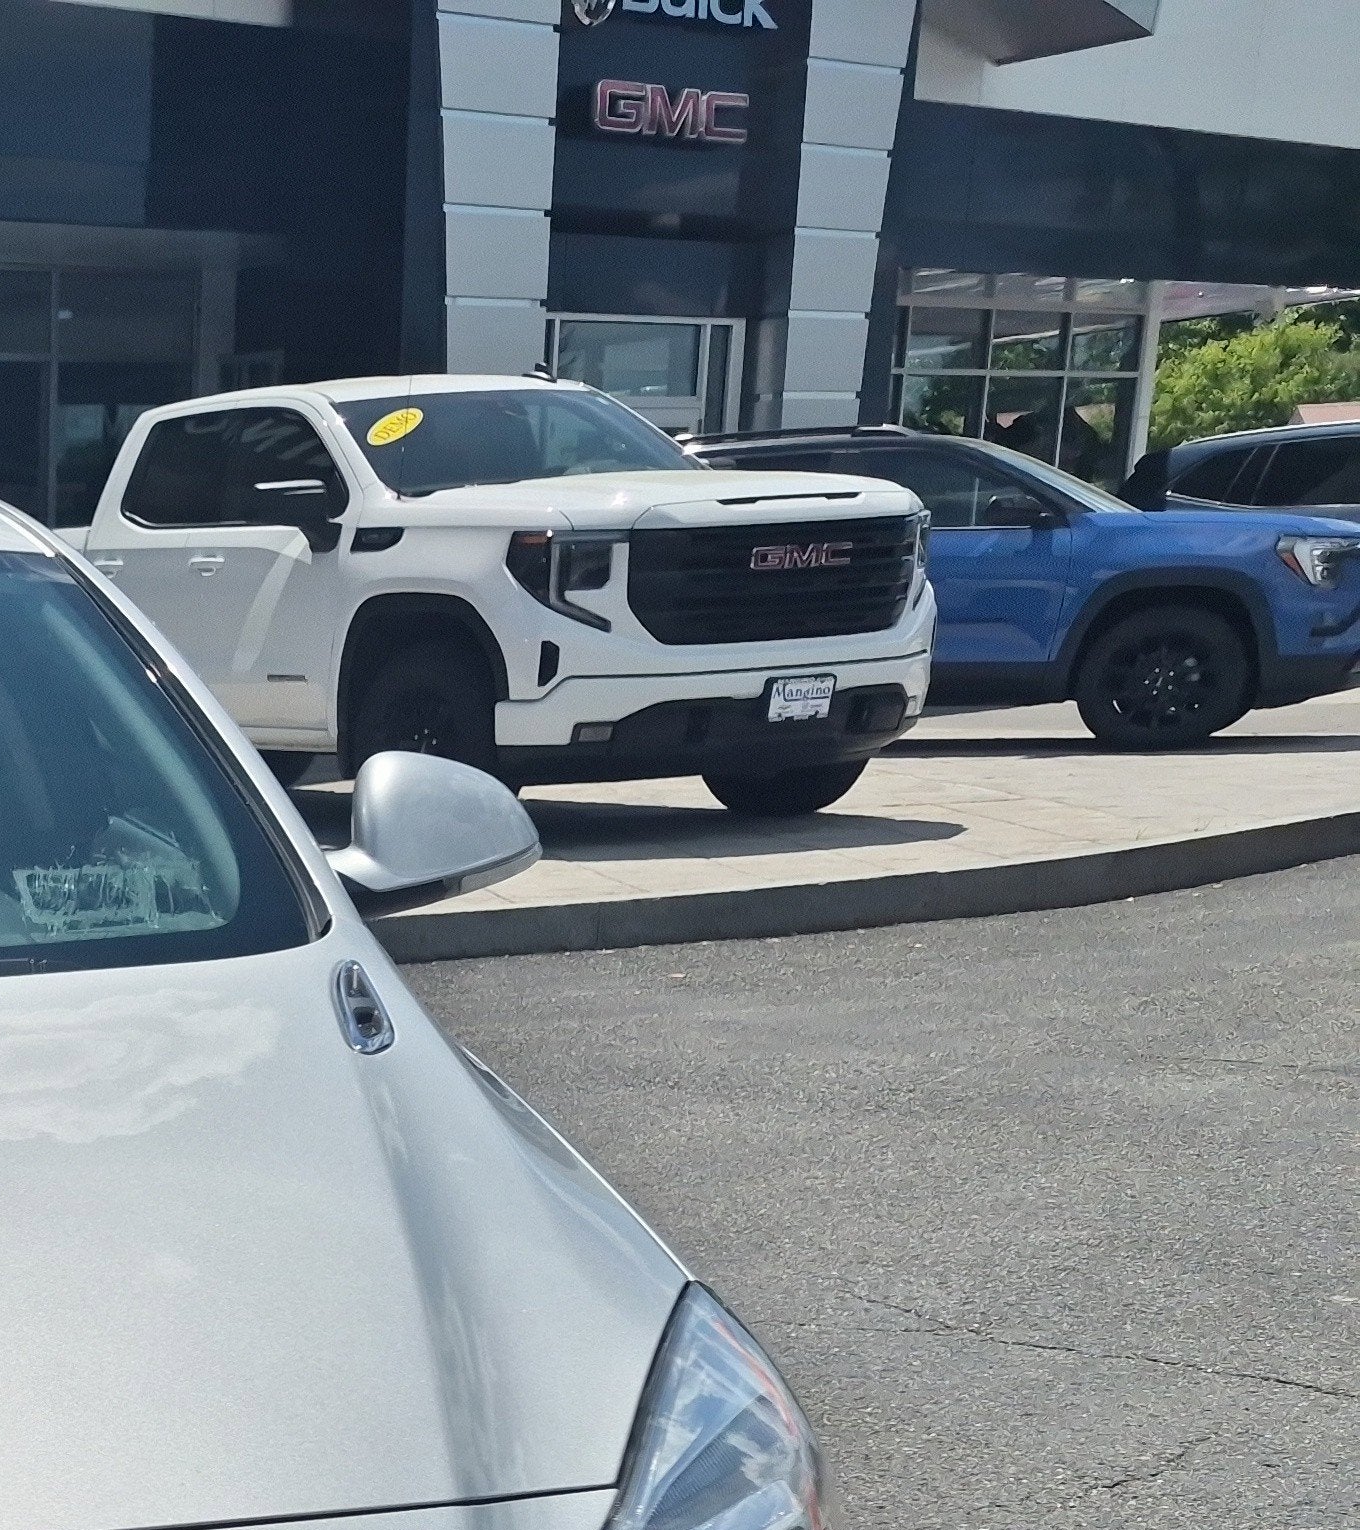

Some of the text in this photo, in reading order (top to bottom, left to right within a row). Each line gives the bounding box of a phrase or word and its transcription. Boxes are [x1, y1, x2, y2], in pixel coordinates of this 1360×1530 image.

[622, 0, 778, 30] uick
[596, 78, 750, 144] GMC
[373, 412, 417, 440] DEMO
[749, 541, 853, 570] GMC
